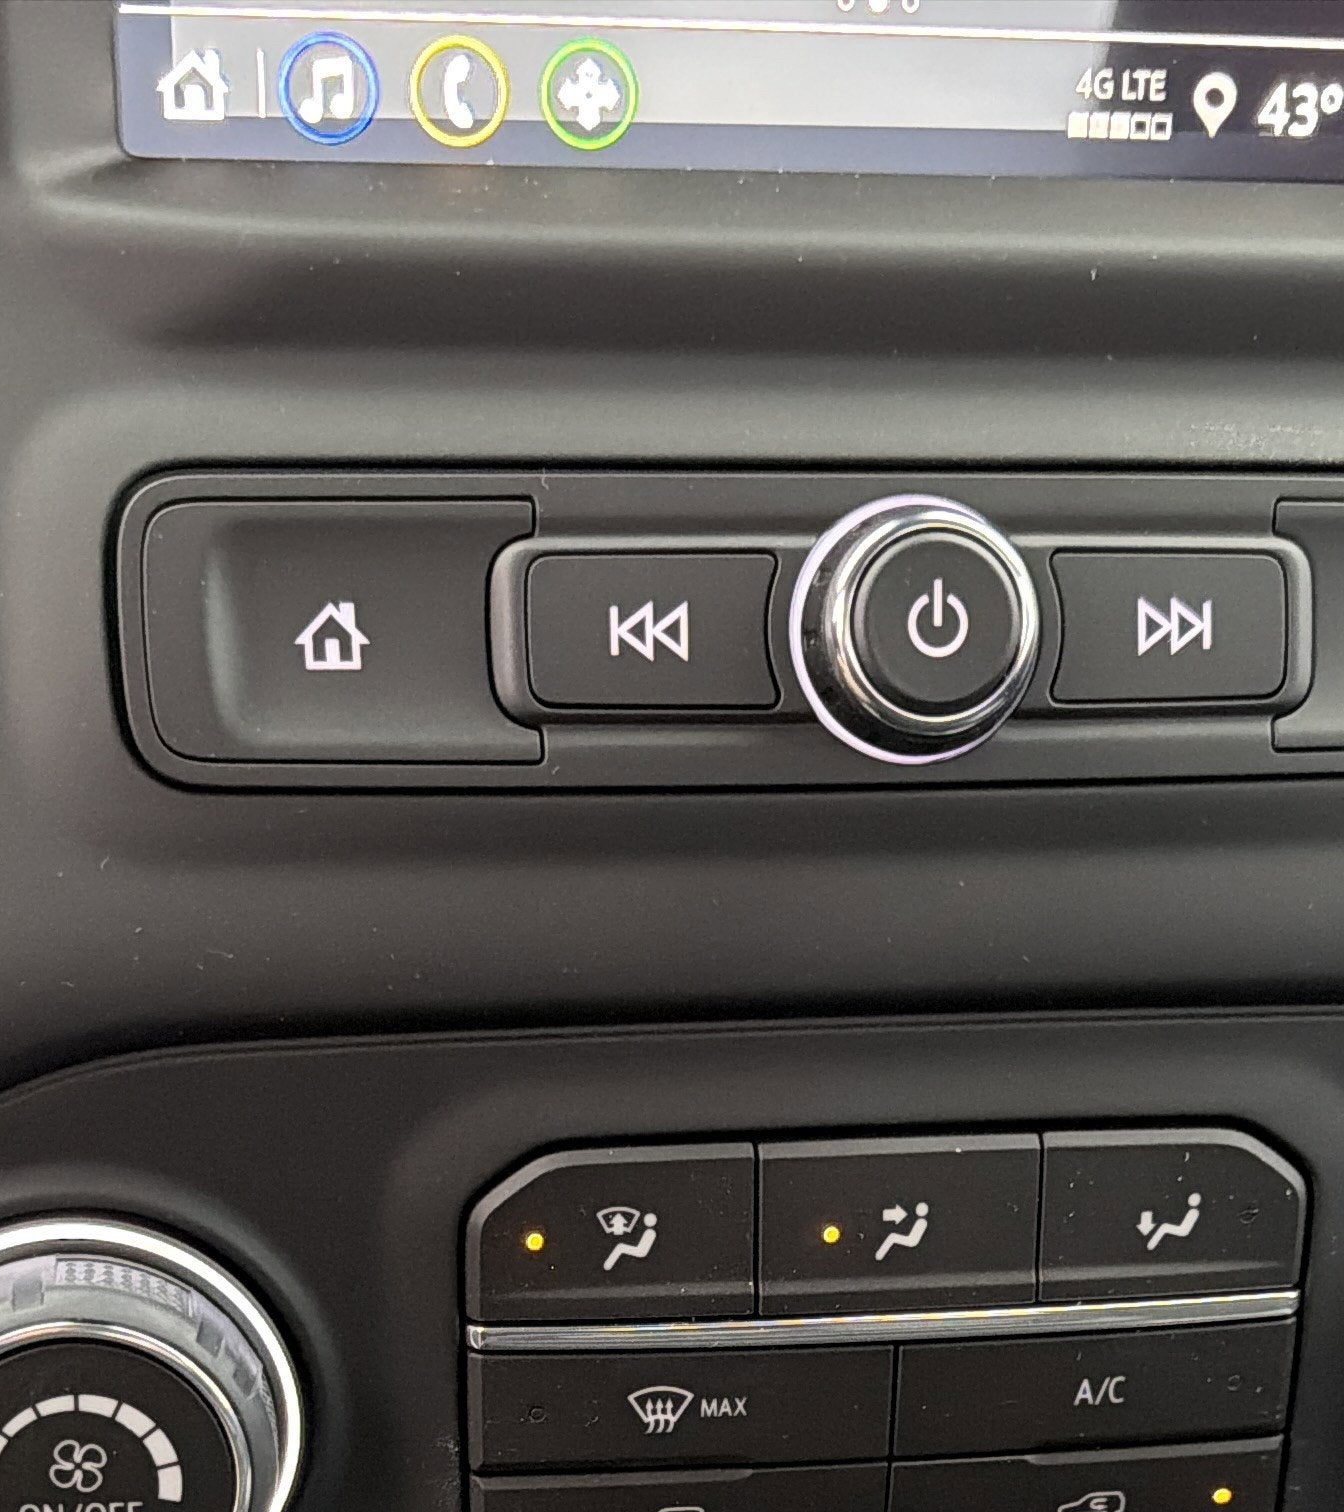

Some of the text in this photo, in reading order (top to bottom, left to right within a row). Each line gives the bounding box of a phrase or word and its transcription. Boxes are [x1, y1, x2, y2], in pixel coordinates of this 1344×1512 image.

[1076, 68, 1167, 102] 4G LTE
[1074, 1375, 1127, 1407] A/C
[700, 1397, 748, 1419] MAX
